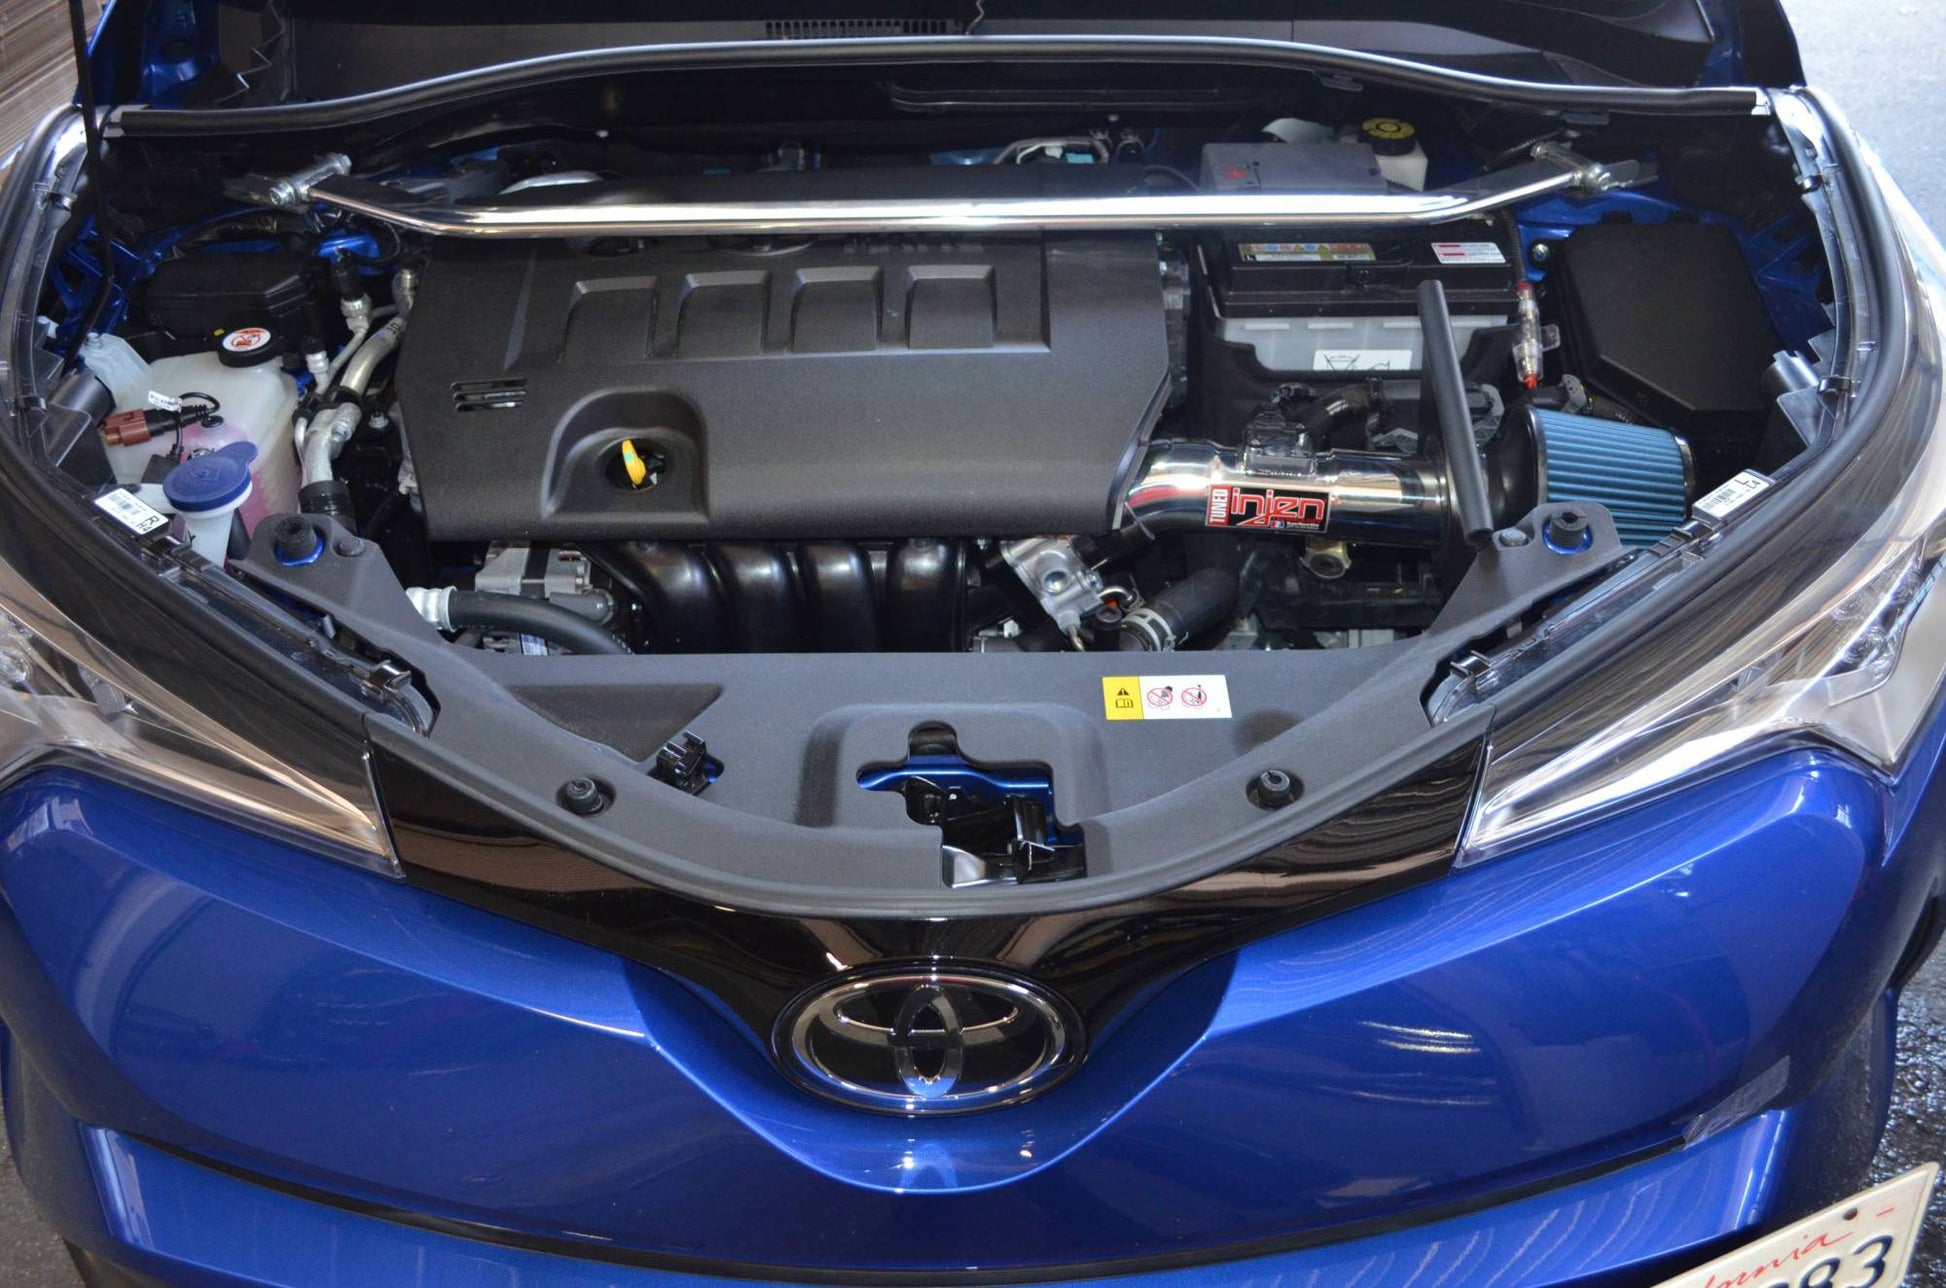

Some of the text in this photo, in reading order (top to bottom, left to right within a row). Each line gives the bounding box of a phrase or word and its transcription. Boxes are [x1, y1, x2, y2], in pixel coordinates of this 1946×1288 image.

[145, 515, 160, 525] R
[1209, 488, 1229, 523] TUNED
[1231, 487, 1325, 526] injen
[1704, 1231, 1853, 1288] ornia
[1766, 1234, 1894, 1288] 83
